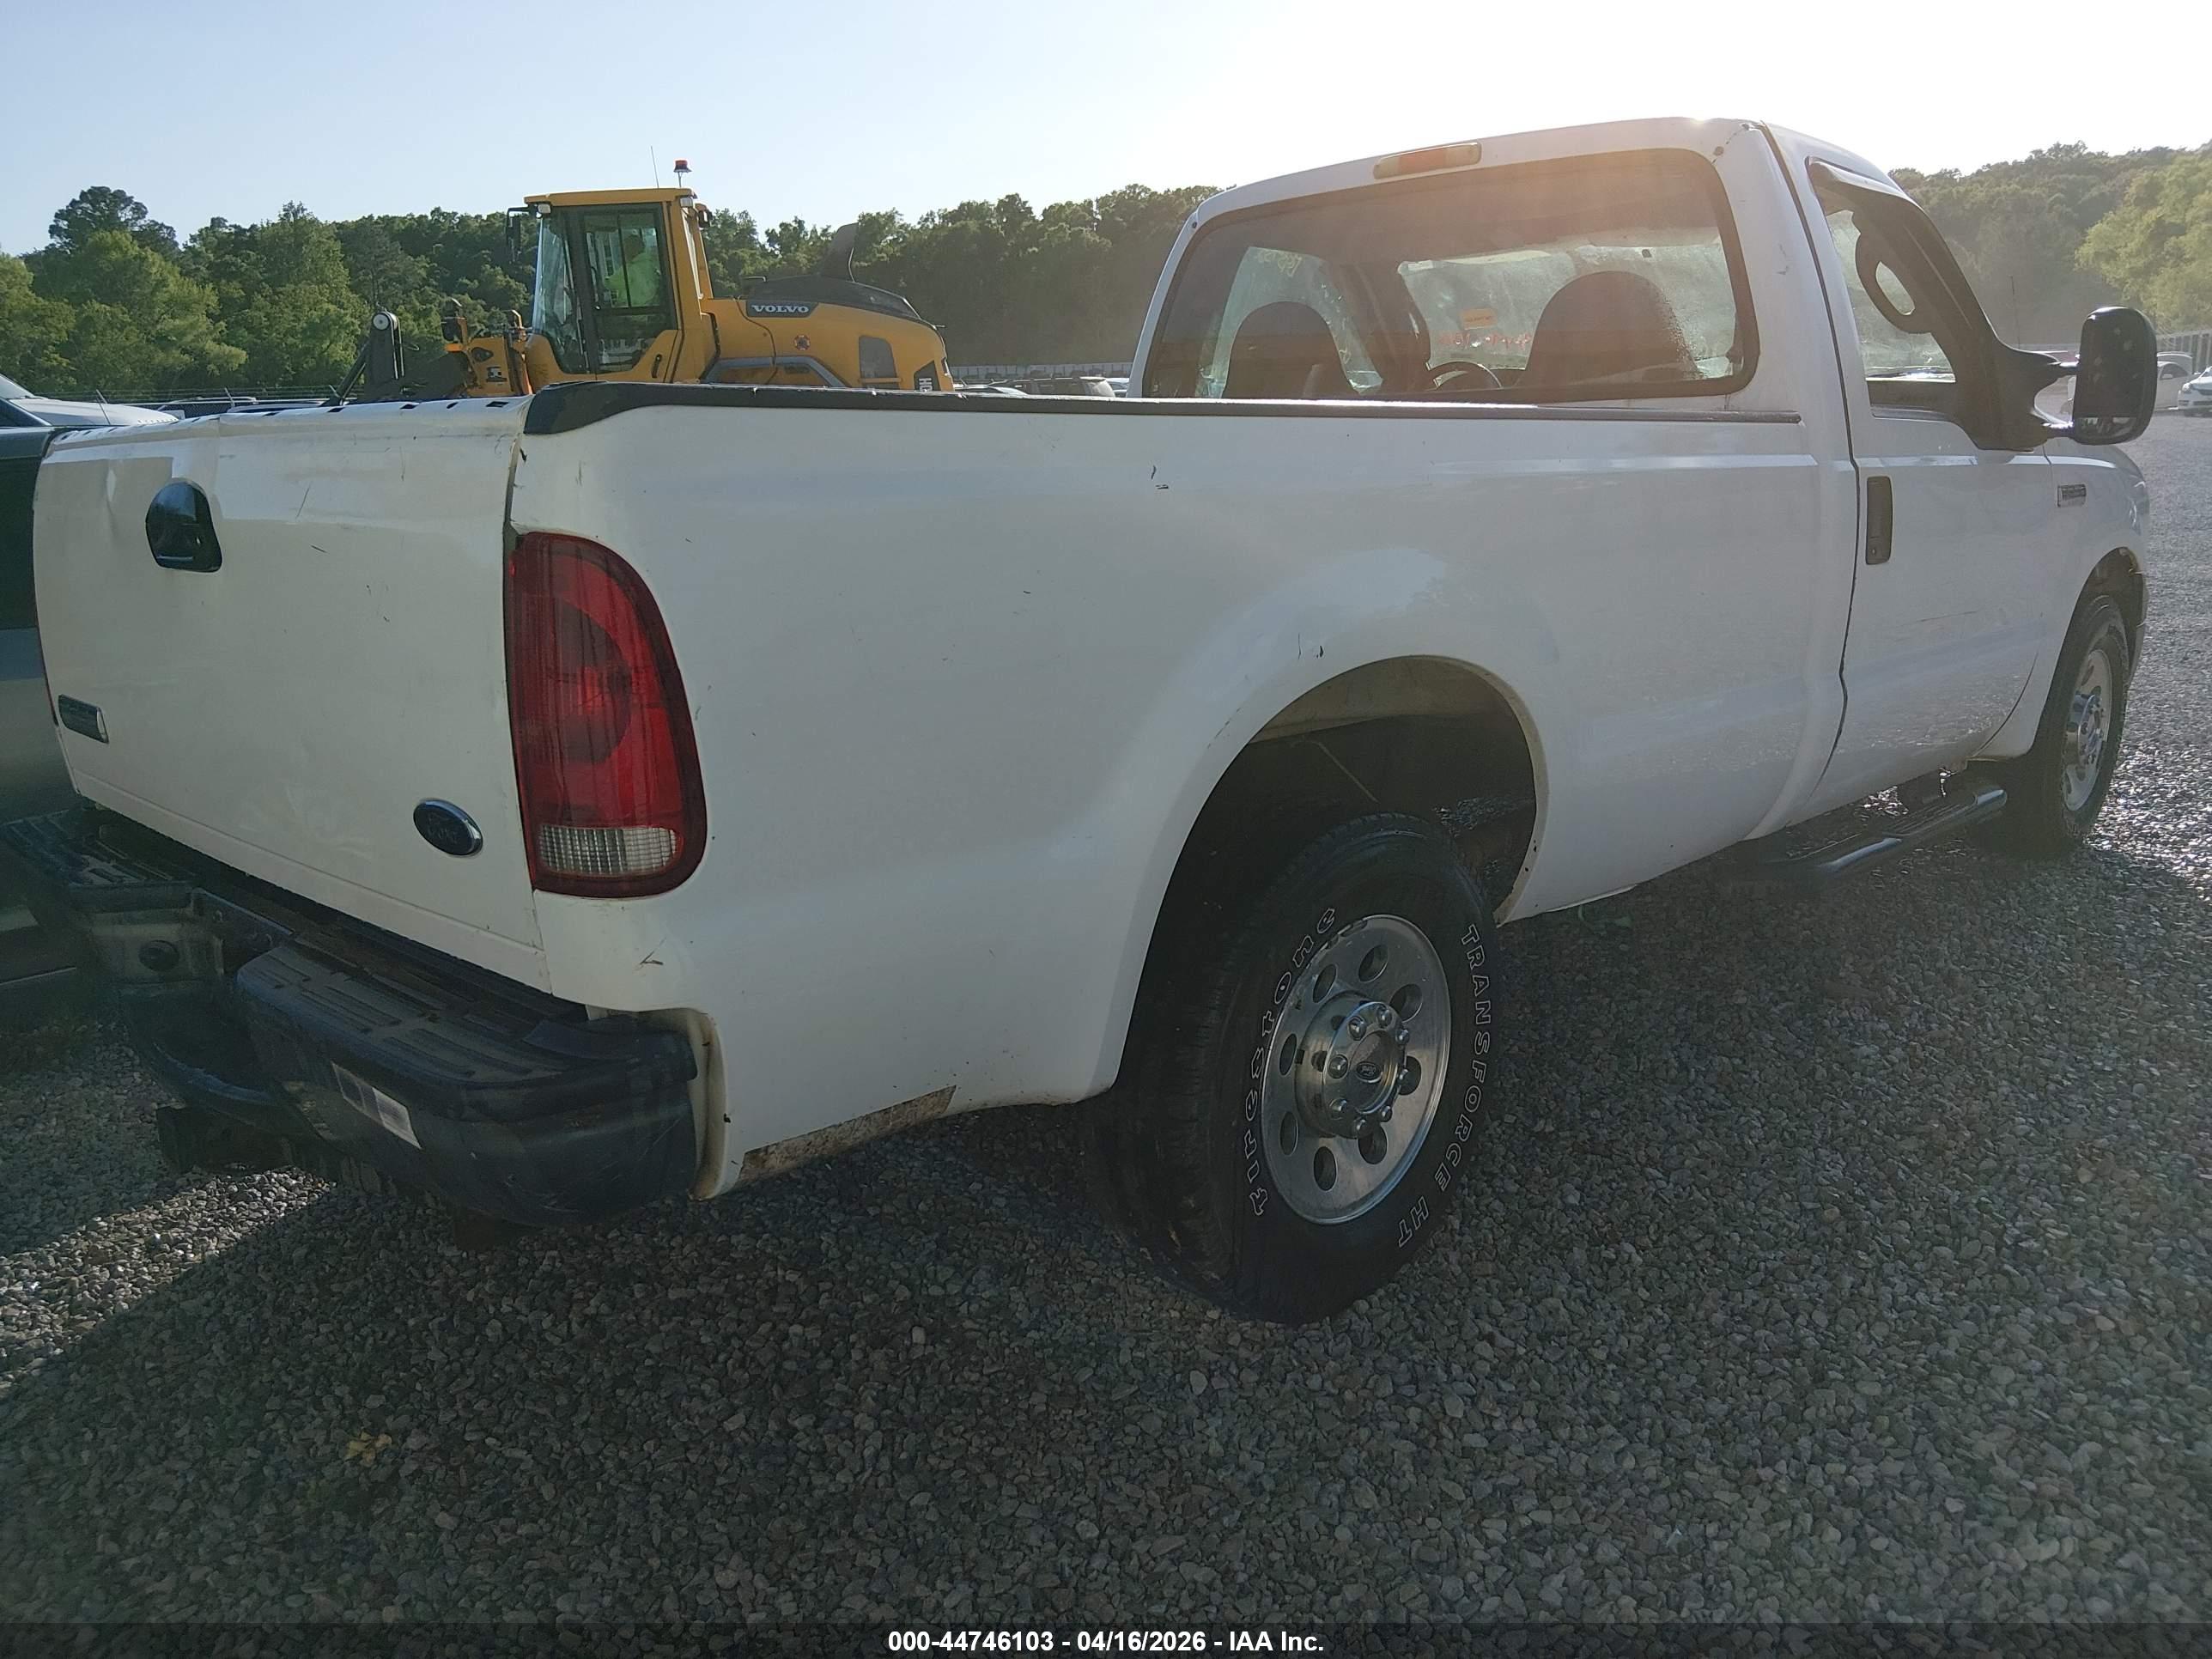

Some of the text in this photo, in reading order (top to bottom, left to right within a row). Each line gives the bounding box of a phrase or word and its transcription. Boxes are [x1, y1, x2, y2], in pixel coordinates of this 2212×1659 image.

[751, 304, 809, 313] VOLVO
[1397, 923, 1492, 1248] TRANSFORCE HT
